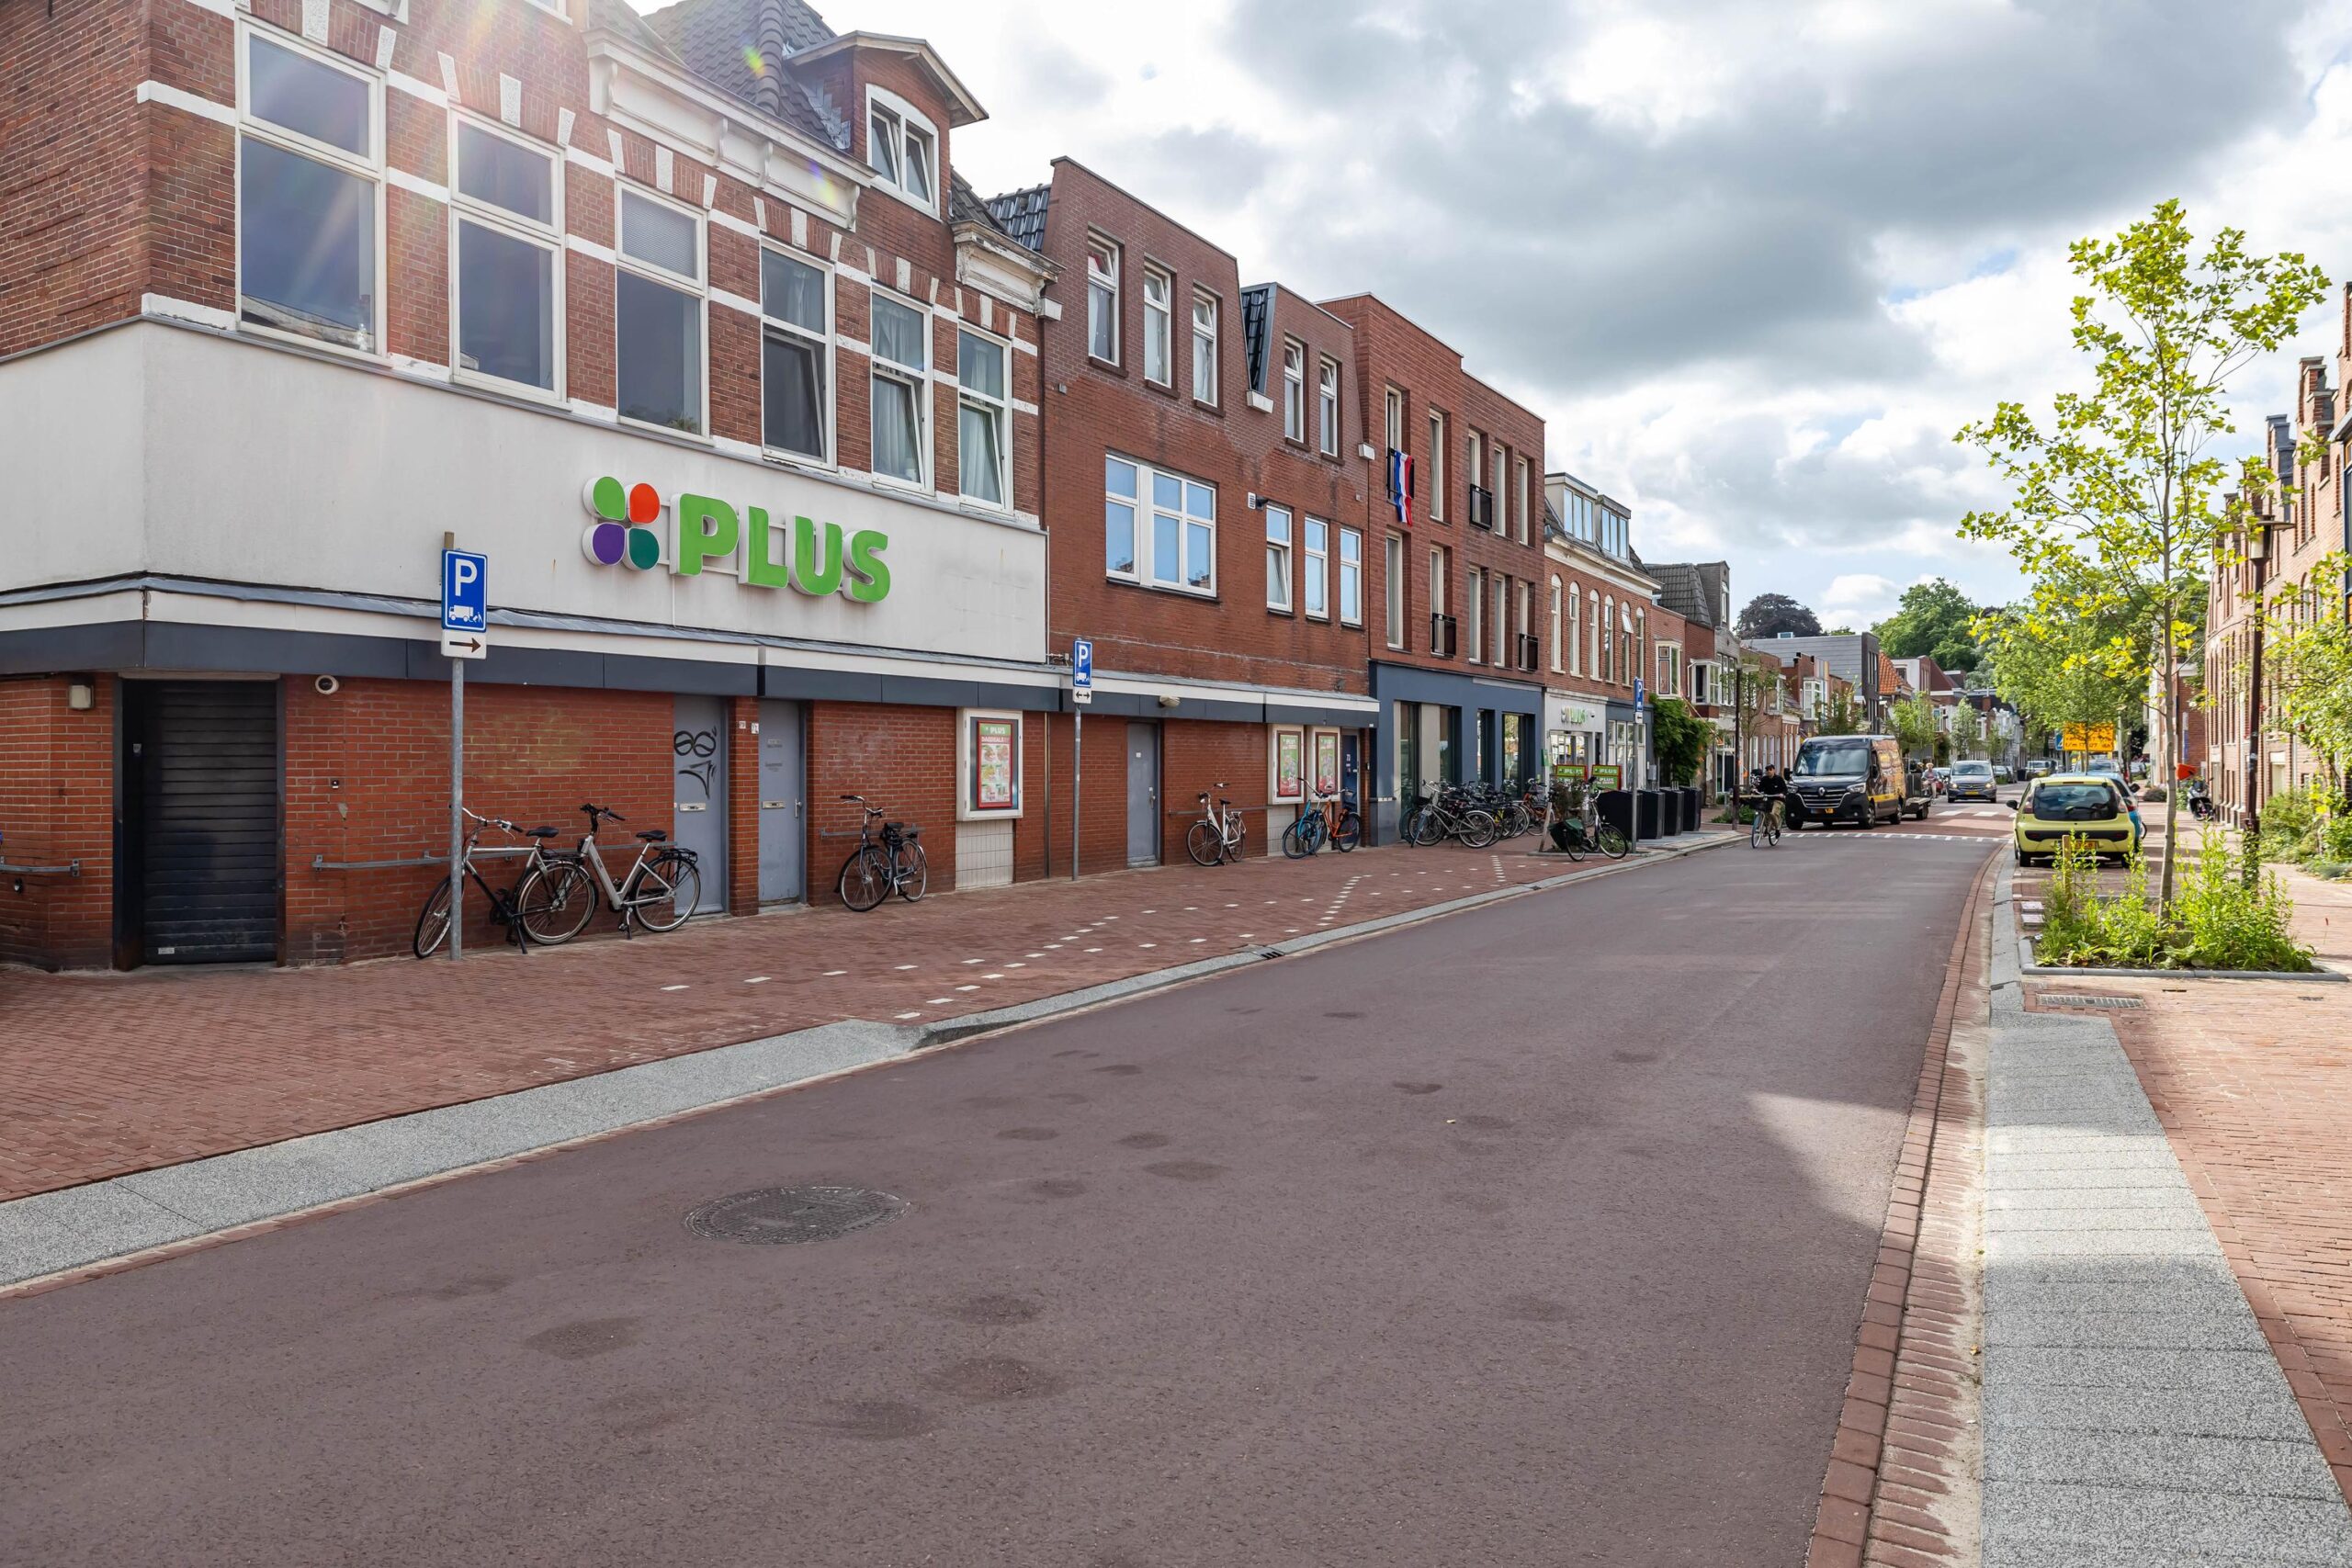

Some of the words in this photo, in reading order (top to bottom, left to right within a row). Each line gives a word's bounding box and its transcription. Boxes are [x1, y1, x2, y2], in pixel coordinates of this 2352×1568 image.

[670, 492, 891, 604] PLUS
[455, 558, 478, 597] P
[1079, 644, 1089, 668] P
[989, 727, 1006, 735] PLUS
